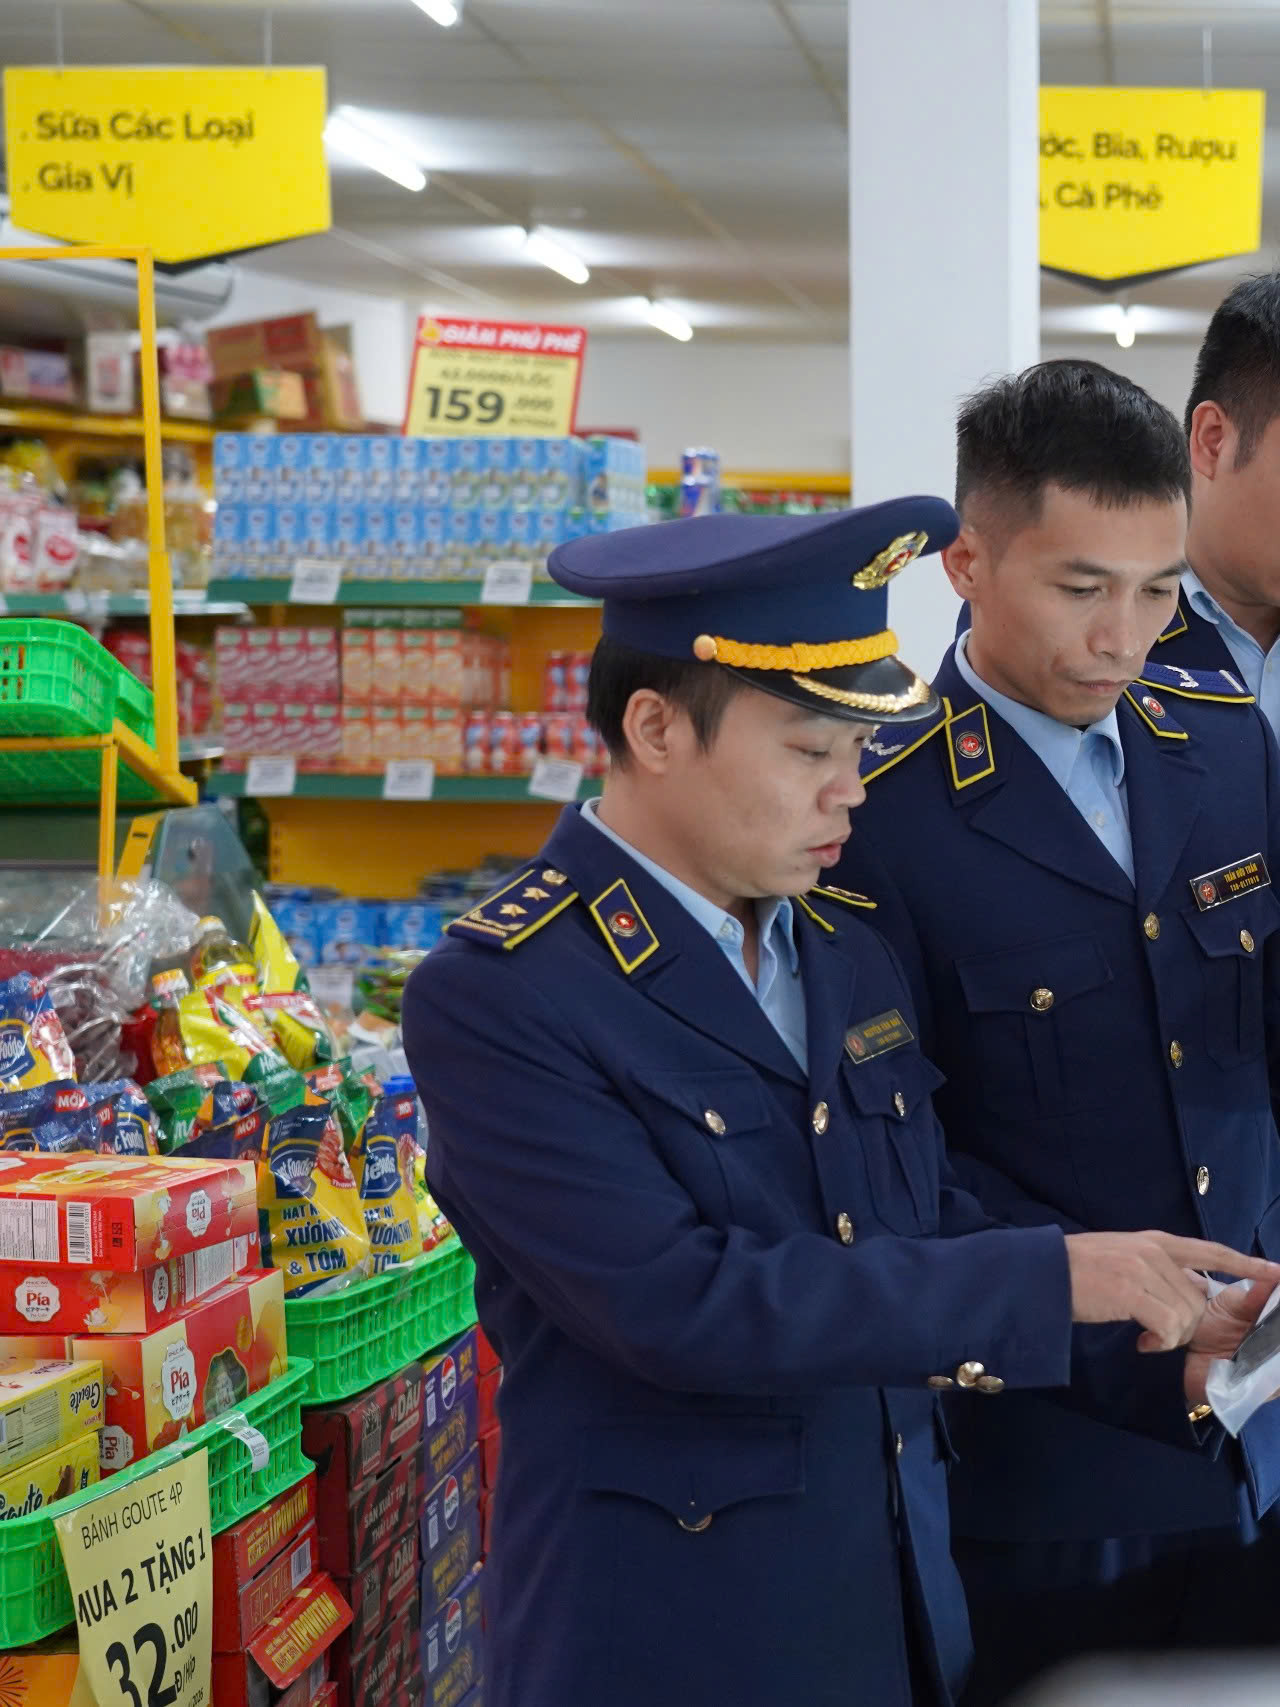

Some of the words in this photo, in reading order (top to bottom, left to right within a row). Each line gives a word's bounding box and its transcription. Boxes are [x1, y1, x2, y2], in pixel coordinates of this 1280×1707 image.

[109, 110, 174, 141] Các
[184, 109, 255, 149] Loại
[38, 161, 93, 192] Gia
[100, 161, 133, 199] Vị
[426, 385, 506, 425] 159
[289, 1260, 303, 1275] &
[305, 1247, 347, 1274] TÔM
[27, 1292, 50, 1306] Pía
[170, 1367, 190, 1395] Pía
[104, 1436, 118, 1460] Pía
[81, 1513, 119, 1551] BÁNH
[121, 1489, 168, 1530] GOUTE
[169, 1481, 183, 1507] 4P
[121, 1568, 139, 1605] 2
[140, 1539, 195, 1595] TẶNG
[198, 1527, 206, 1562] 1
[105, 1622, 178, 1707] 32
[170, 1600, 198, 1654] .000
